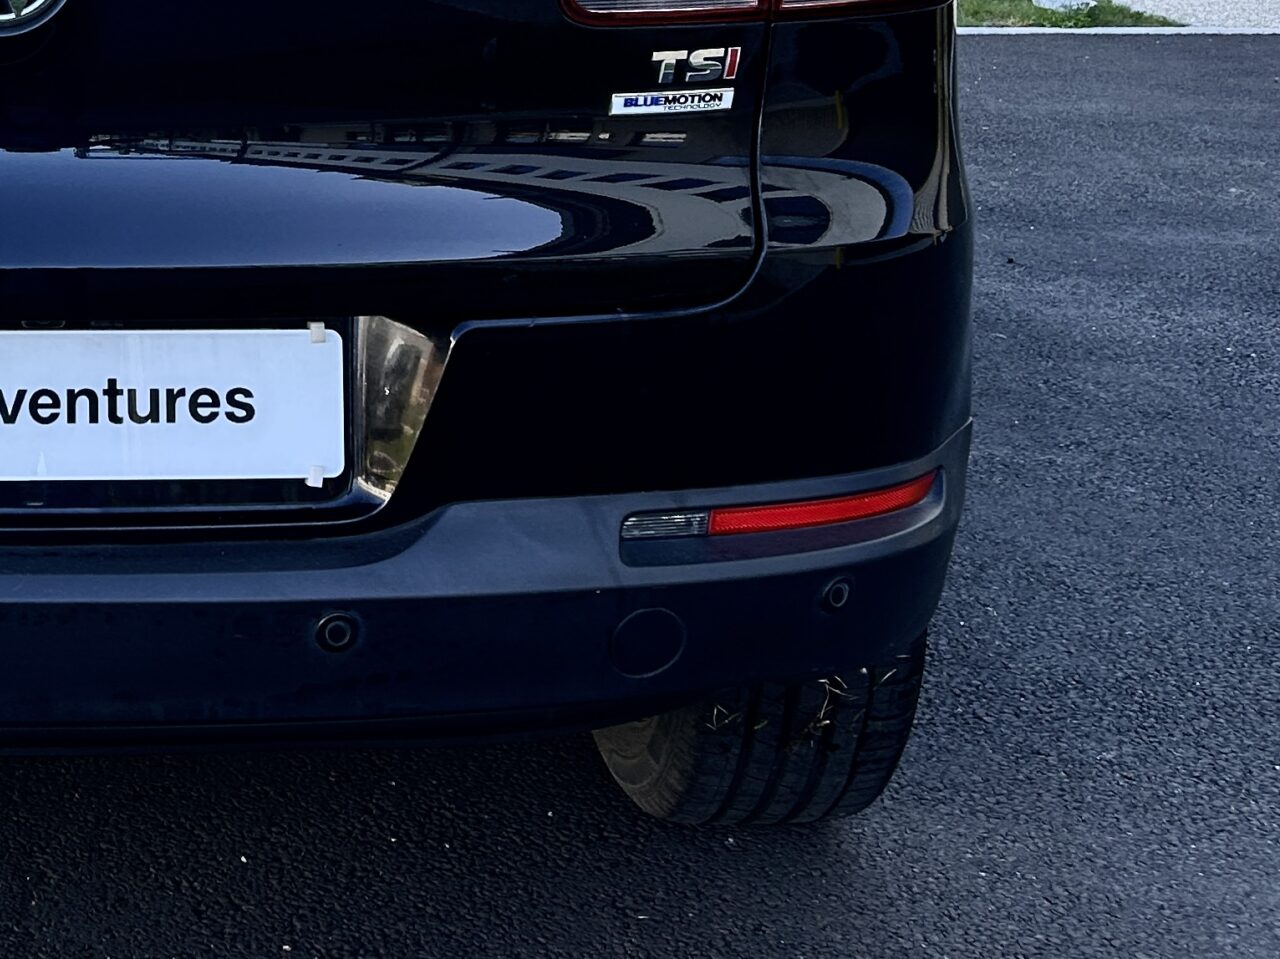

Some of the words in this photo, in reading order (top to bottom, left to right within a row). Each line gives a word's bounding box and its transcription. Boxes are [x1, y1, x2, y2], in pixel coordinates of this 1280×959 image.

[651, 46, 741, 83] TSI
[623, 93, 724, 108] BLUEMOTION
[664, 103, 722, 111] TECHNOLOGY
